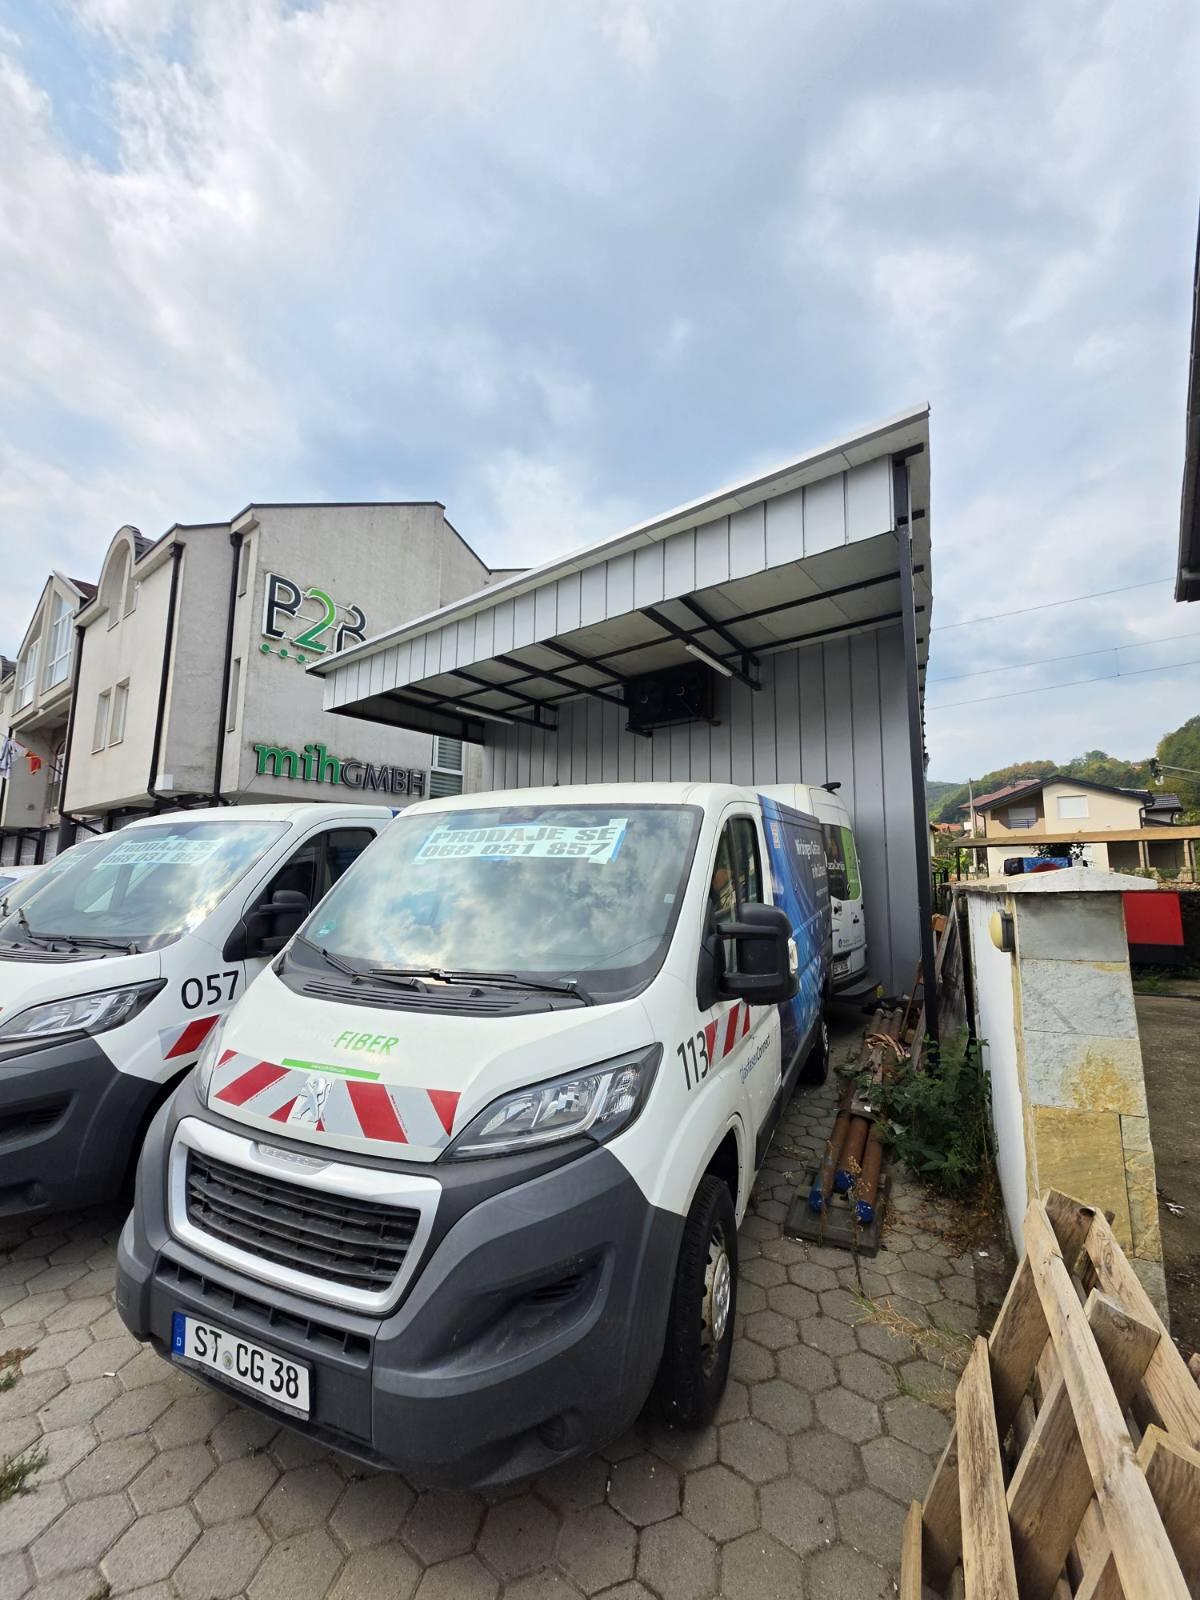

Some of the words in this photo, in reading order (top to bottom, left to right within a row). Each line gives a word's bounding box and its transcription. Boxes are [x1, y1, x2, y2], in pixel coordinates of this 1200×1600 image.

[430, 827, 565, 844] PRODAJE
[575, 827, 616, 841] SE
[135, 851, 164, 863] 031
[420, 844, 475, 858] 068
[480, 843, 536, 856] 031
[547, 842, 610, 856] 857
[181, 970, 239, 1009] 057
[333, 1030, 399, 1056] FIBER
[677, 1030, 708, 1091] 113
[176, 1336, 182, 1347] D
[194, 1325, 222, 1362] ST
[236, 1343, 264, 1385] CG
[270, 1357, 299, 1399] 38
